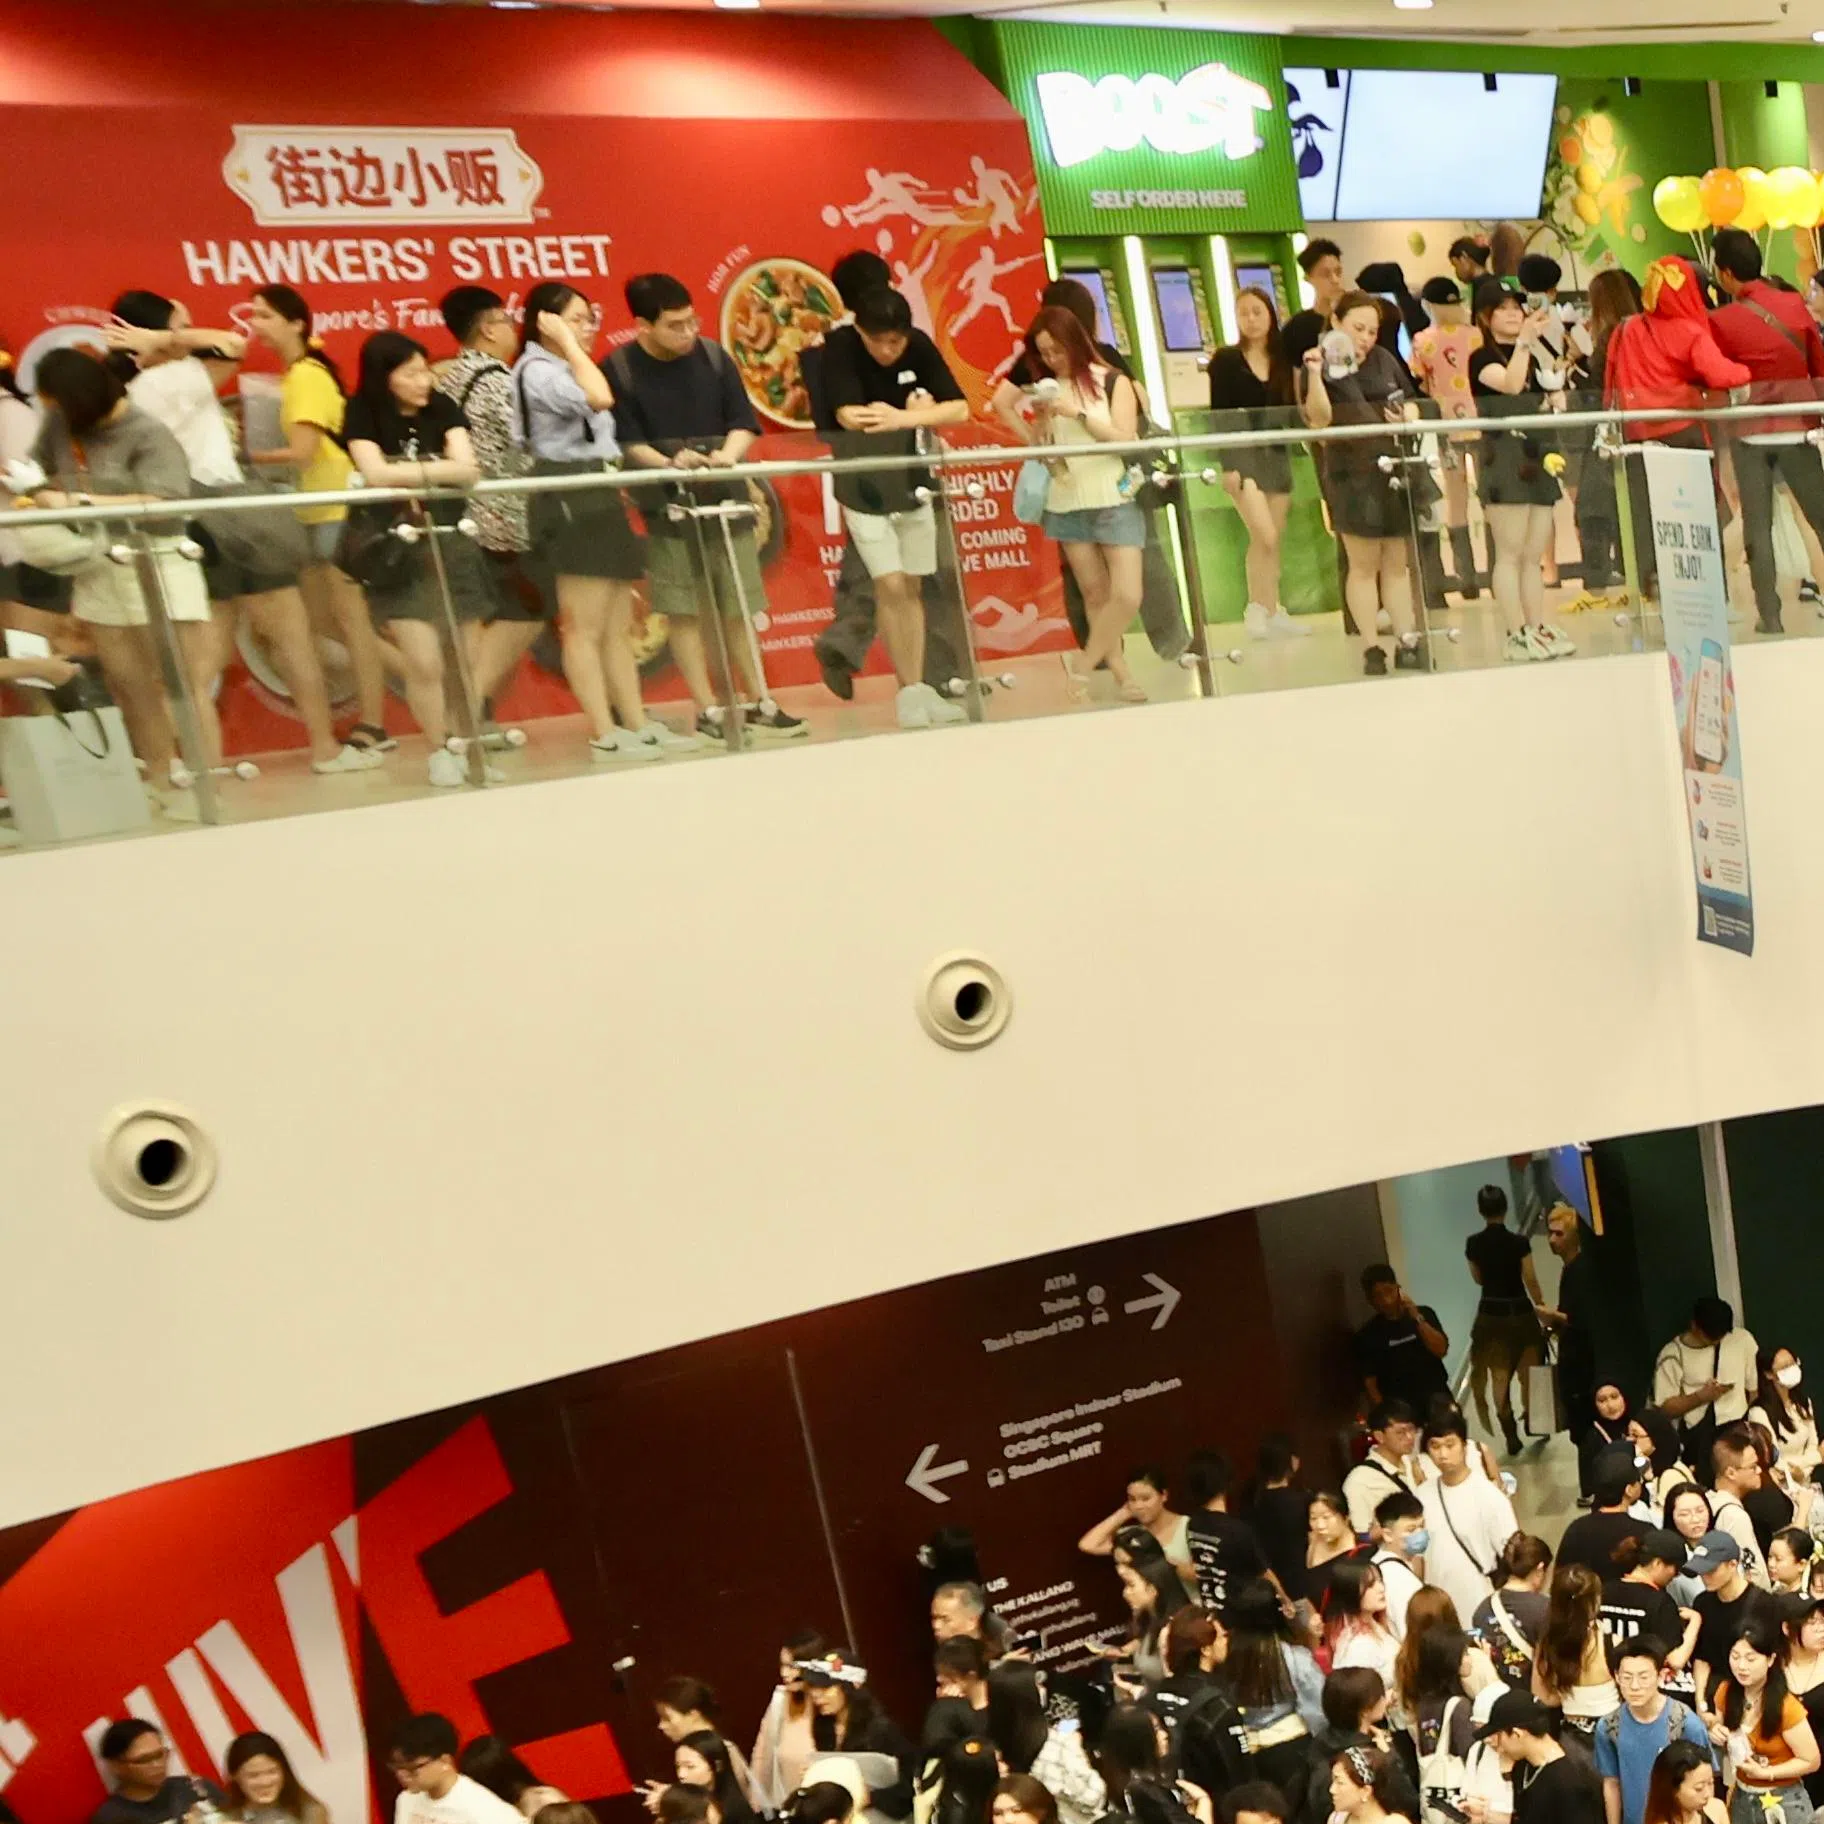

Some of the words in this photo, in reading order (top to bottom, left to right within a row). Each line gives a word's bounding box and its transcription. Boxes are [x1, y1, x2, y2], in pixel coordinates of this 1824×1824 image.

[264, 143, 506, 211] 街边小贩
[1091, 189, 1136, 209] SELF
[1137, 189, 1196, 209] ORDER
[1197, 189, 1248, 209] HERE
[181, 237, 437, 286] HAWKERS'
[448, 234, 612, 281] STREET
[961, 526, 1027, 549] COMING
[1656, 521, 1689, 549] SPEND.
[985, 550, 1030, 571] MALL
[1672, 553, 1706, 582] ENJOY.
[1044, 1272, 1077, 1292] ATM
[981, 1333, 1014, 1353] Taxi
[1013, 1321, 1058, 1345] Stand
[999, 1407, 1075, 1438] Singapore
[1074, 1394, 1122, 1415] Indoor
[1122, 1377, 1182, 1403] Stadium
[1003, 1434, 1050, 1459] OCBC
[1050, 1421, 1104, 1447] Square
[1008, 1452, 1070, 1480] Stadium
[1069, 1440, 1102, 1462] MRT
[1016, 1580, 1076, 1609] KALLANG
